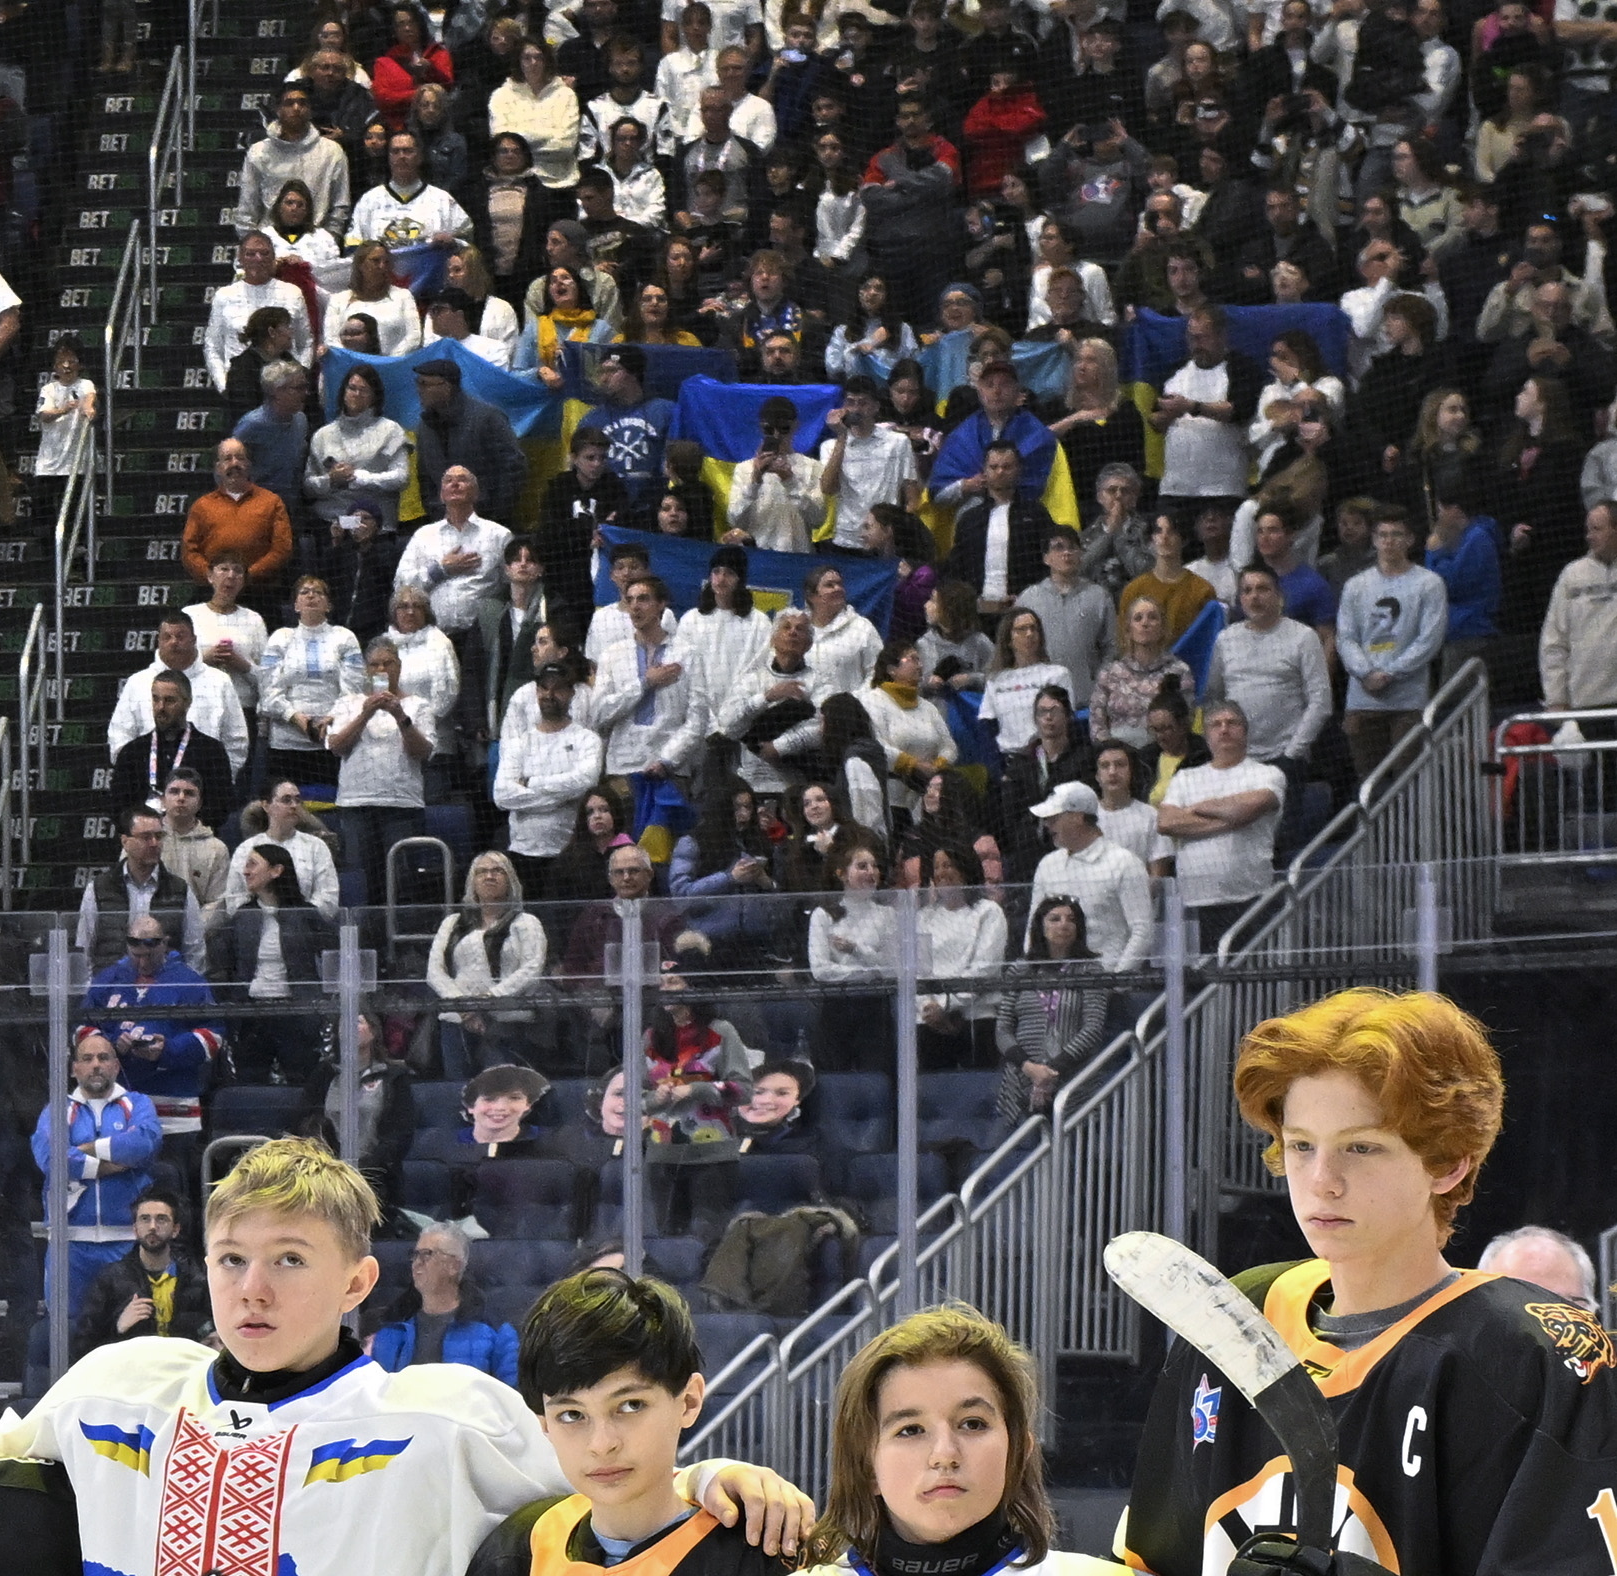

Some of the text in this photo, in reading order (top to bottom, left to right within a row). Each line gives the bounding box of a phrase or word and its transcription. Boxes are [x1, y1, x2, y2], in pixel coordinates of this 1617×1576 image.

[215, 1430, 247, 1440] BAUER
[1402, 1404, 1428, 1478] C
[893, 1553, 978, 1573] BAUER
